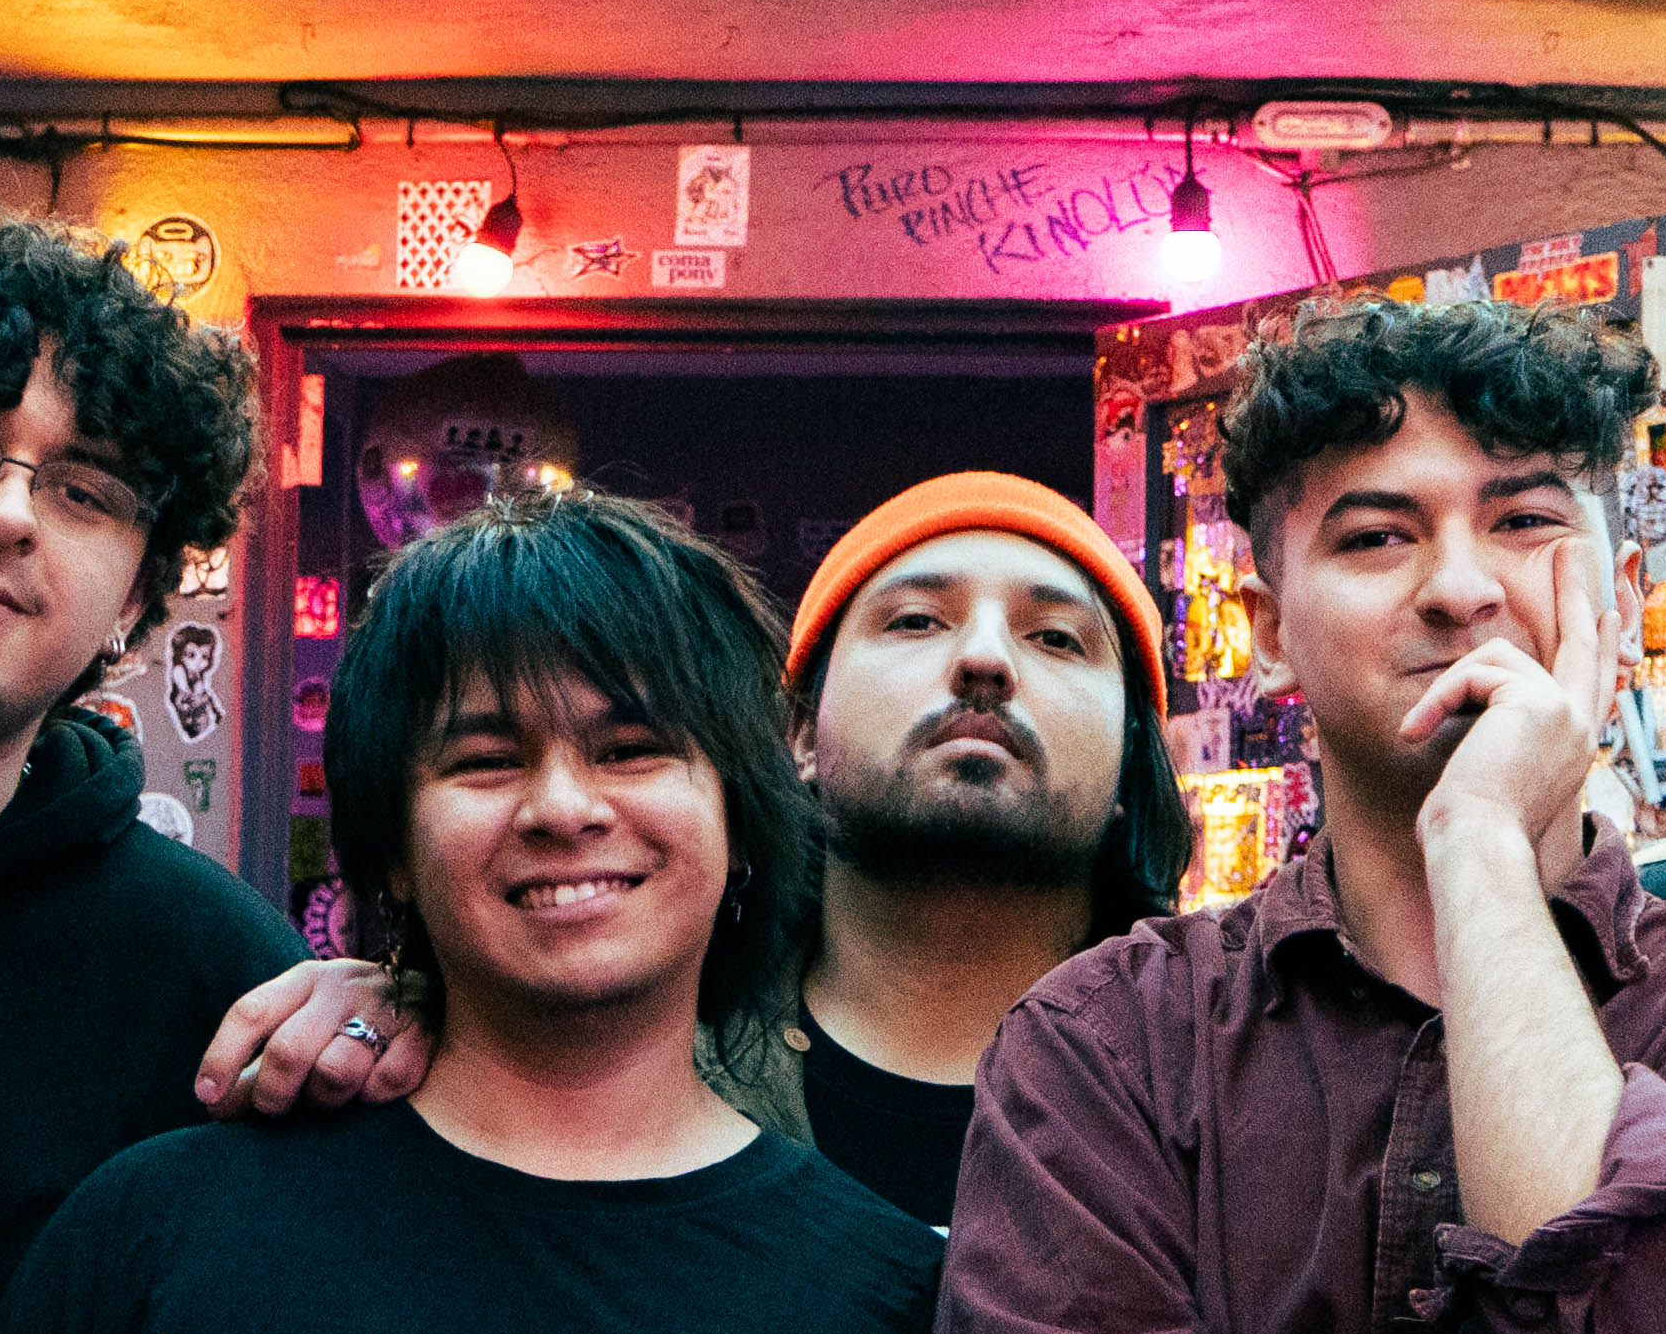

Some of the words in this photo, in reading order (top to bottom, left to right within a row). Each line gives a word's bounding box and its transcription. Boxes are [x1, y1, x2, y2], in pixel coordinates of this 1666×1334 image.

[837, 164, 953, 219] PURO
[898, 164, 1055, 246] PINCHE
[658, 255, 711, 266] coma
